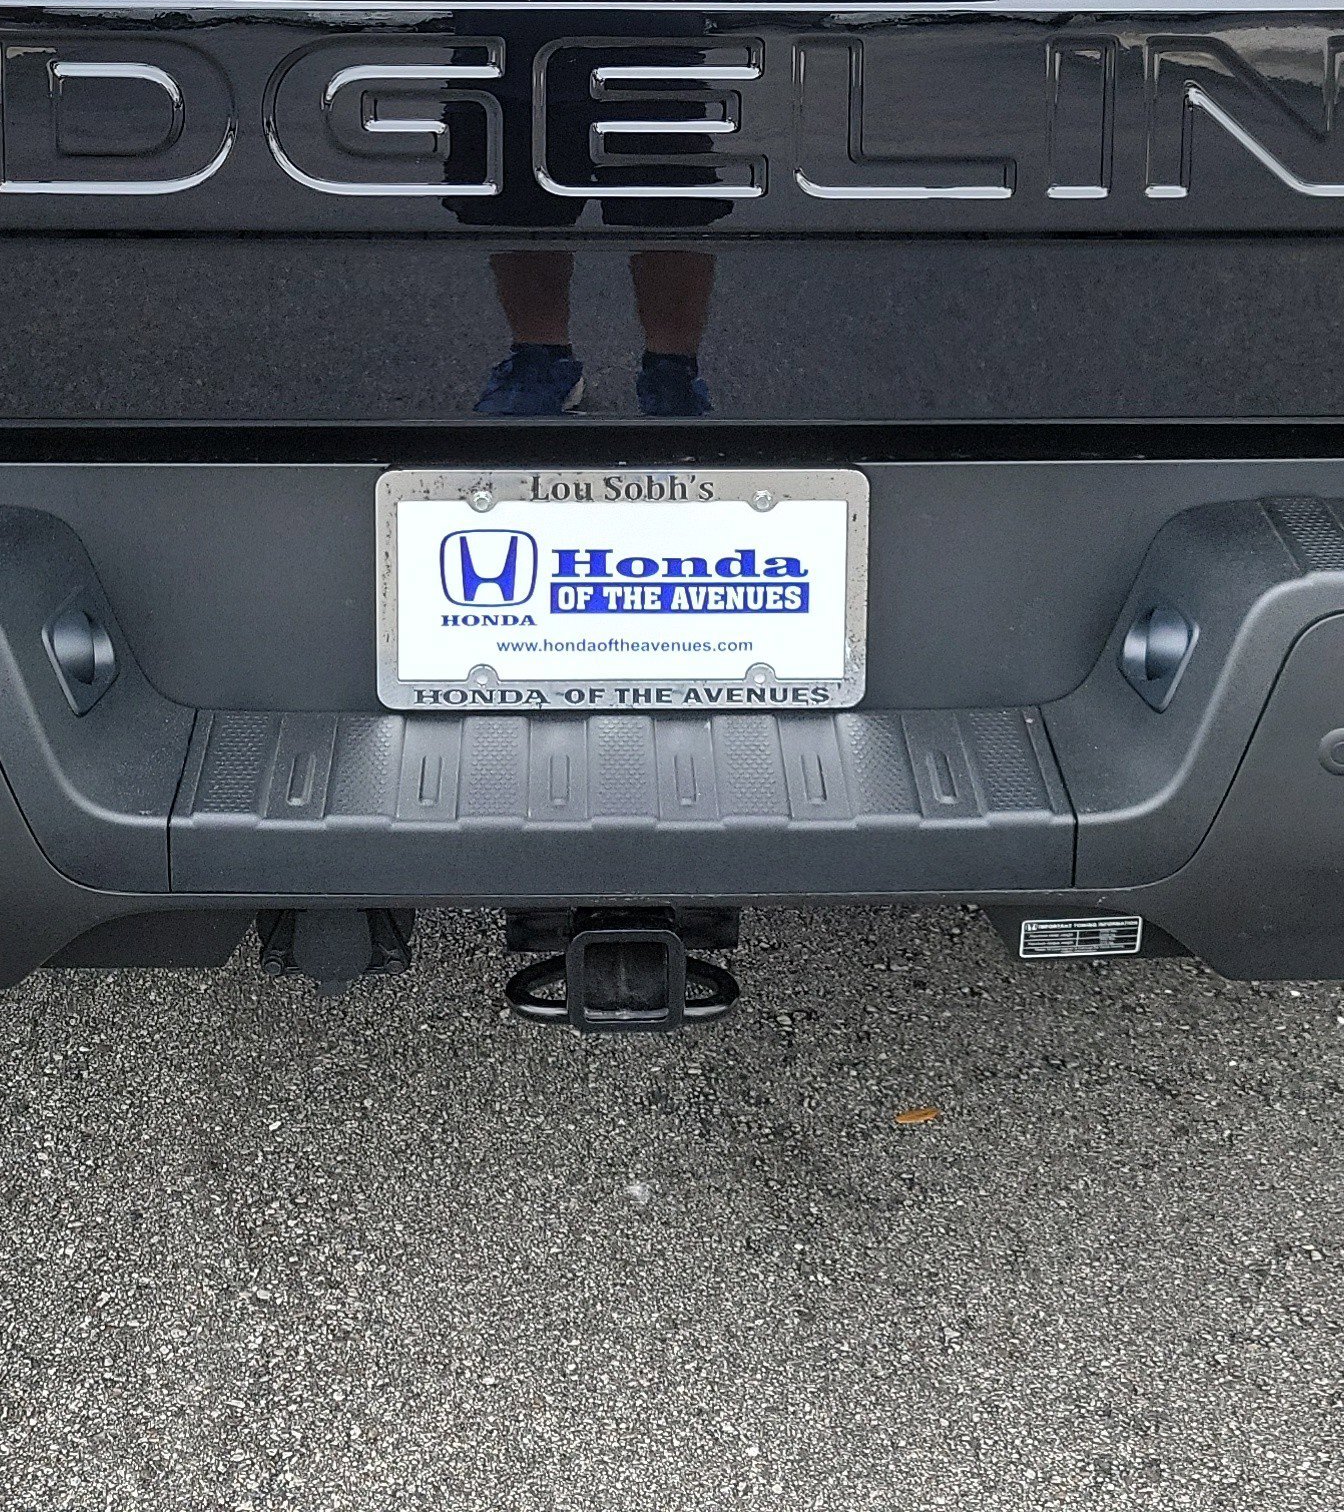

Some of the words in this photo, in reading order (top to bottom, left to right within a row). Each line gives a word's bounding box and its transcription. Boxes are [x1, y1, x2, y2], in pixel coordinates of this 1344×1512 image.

[530, 476, 593, 501] Lou
[604, 476, 714, 501] Sobh's
[551, 549, 808, 578] Honda
[558, 586, 594, 610] OF
[603, 586, 662, 610] THE
[670, 586, 802, 610] AVENUES
[441, 615, 537, 626] HONDA
[497, 638, 753, 652] www.hondaoftheavenues.com
[414, 689, 550, 705] HONDA
[564, 688, 606, 705] OF
[614, 688, 673, 704] THE
[682, 687, 830, 704] AVENUES
